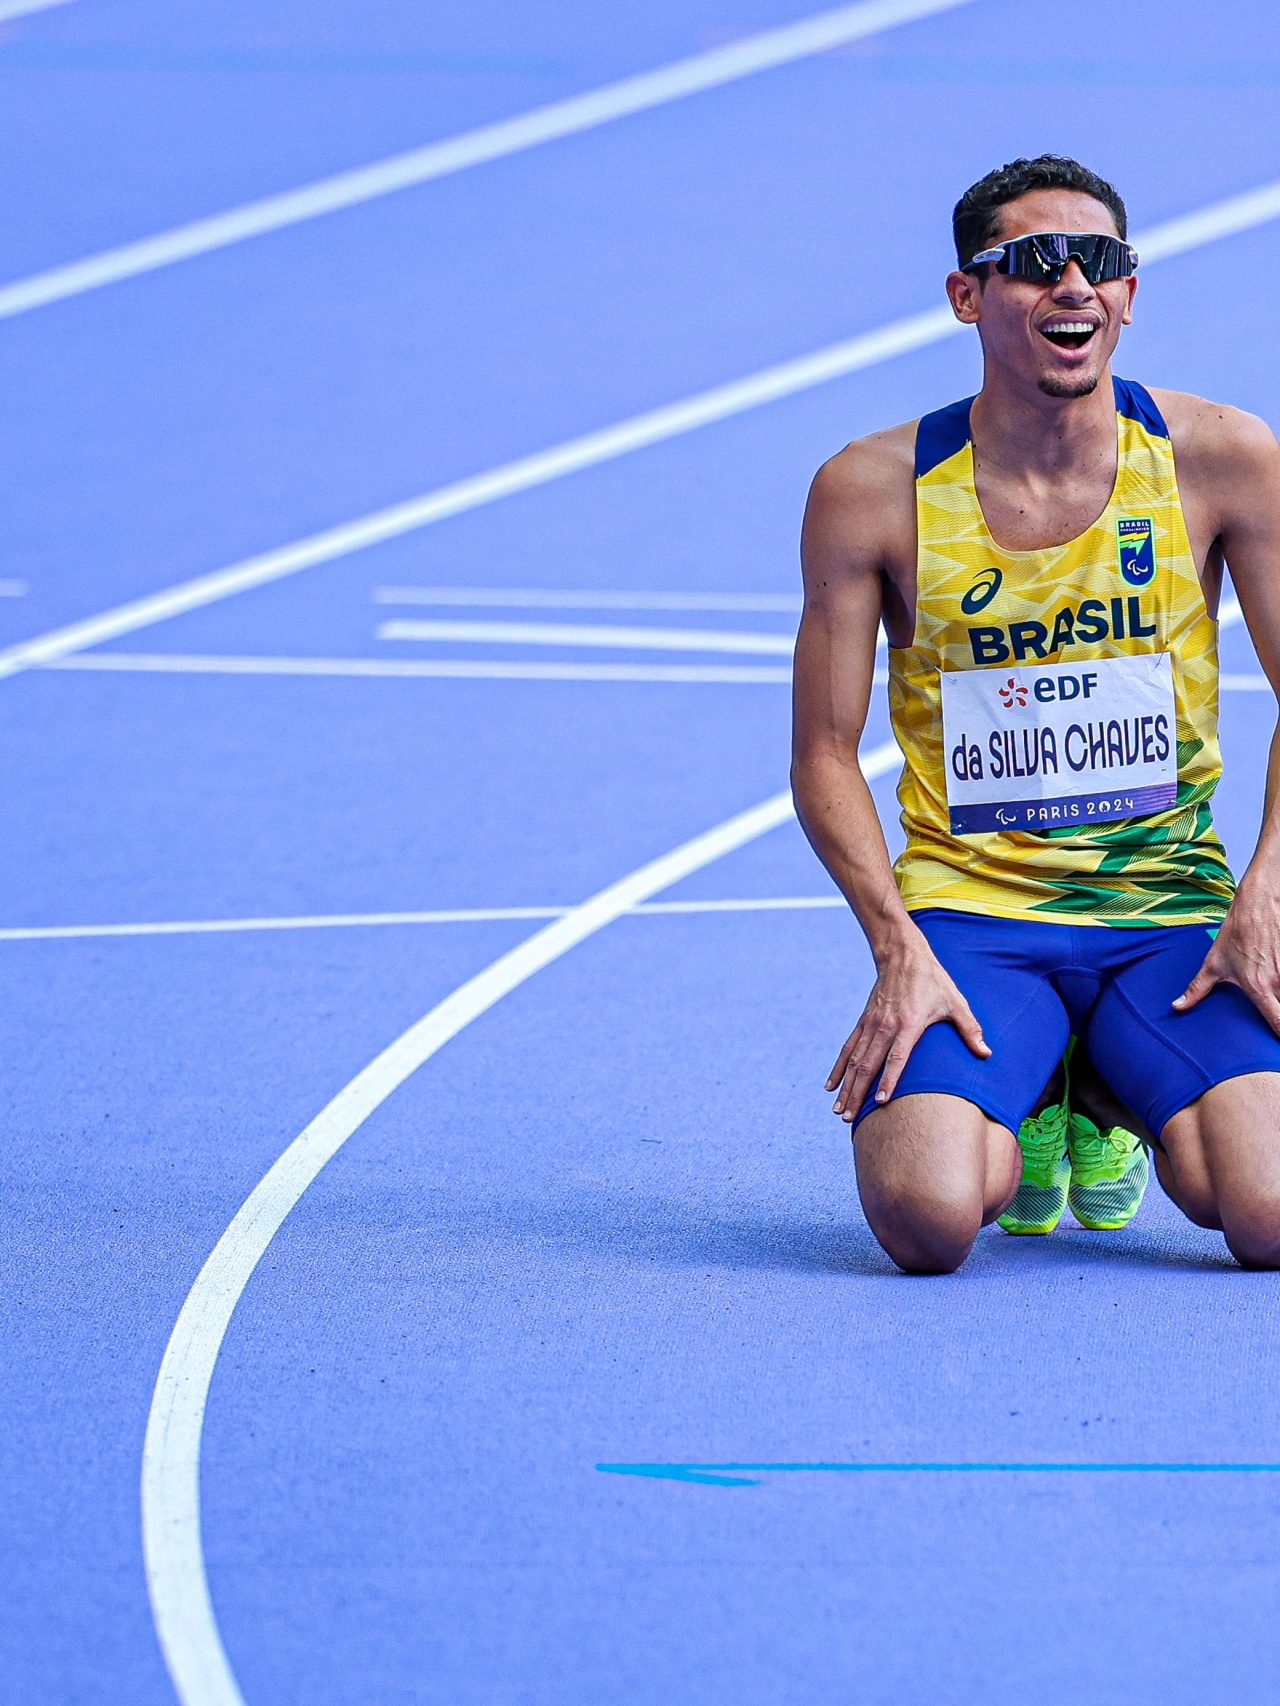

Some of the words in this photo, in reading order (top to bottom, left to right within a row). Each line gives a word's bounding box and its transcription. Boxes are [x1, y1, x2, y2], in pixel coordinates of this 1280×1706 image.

[968, 596, 1157, 665] BRASIL
[952, 733, 983, 782] da
[989, 727, 1059, 778] SILVA
[1065, 713, 1170, 772] CHAVES
[1087, 798, 1134, 815] 2024
